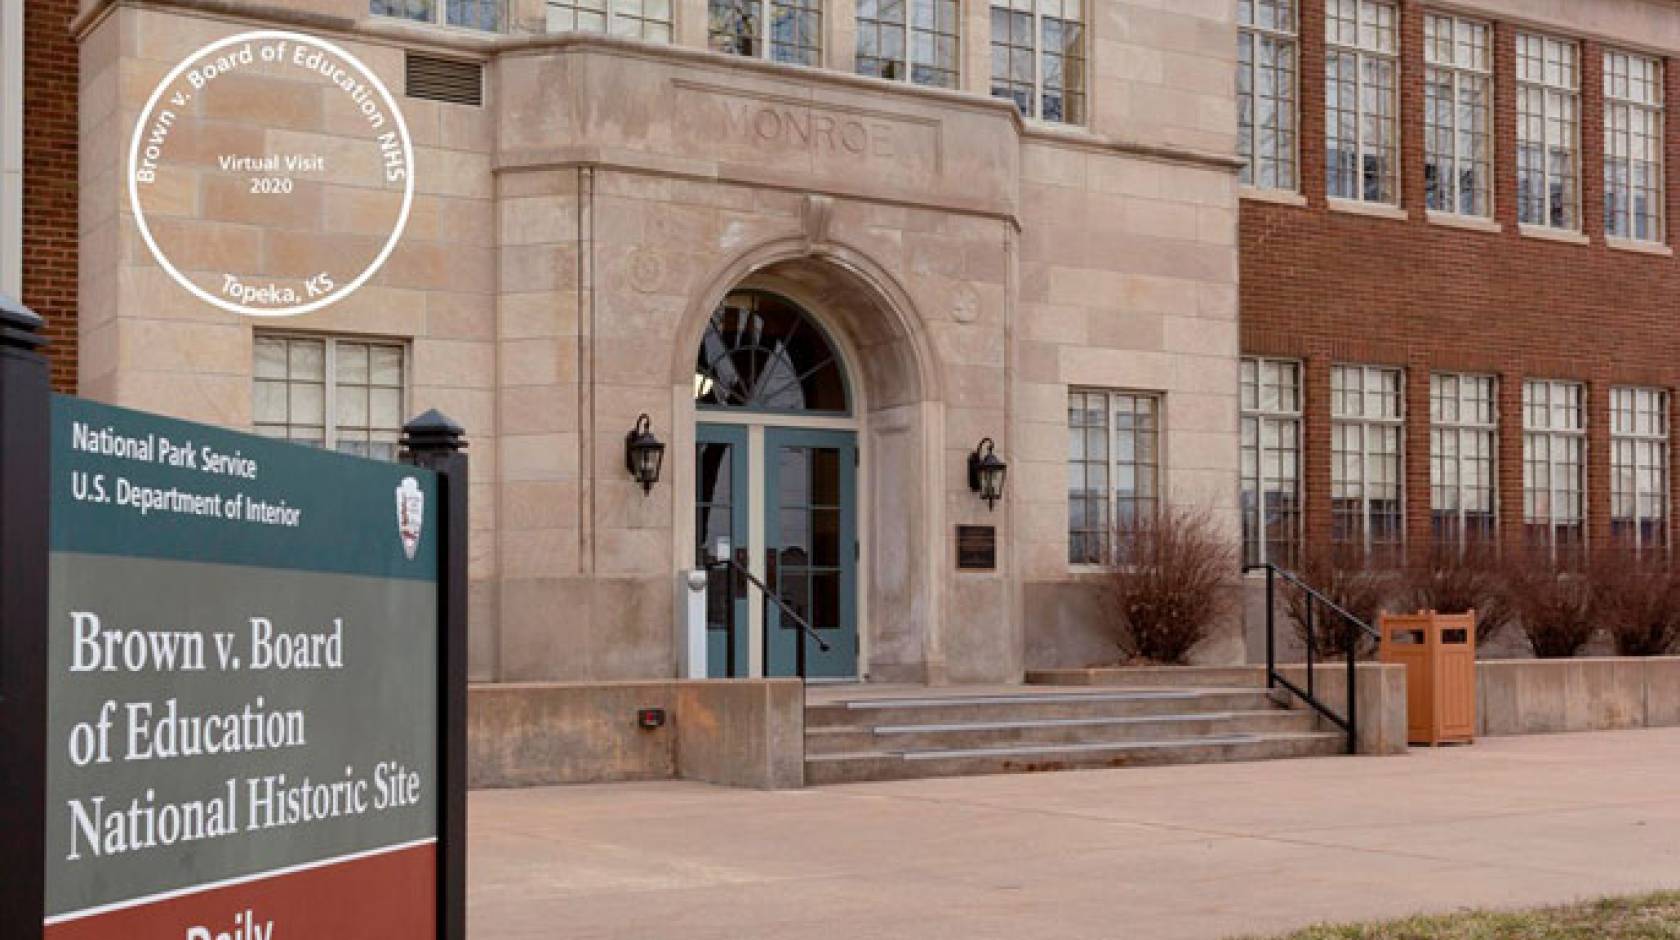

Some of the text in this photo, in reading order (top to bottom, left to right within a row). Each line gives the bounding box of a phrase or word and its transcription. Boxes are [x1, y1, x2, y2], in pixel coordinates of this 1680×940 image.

[722, 101, 896, 157] MONROE
[72, 421, 257, 479] National Park Service
[71, 471, 301, 527] U.S. Department of Interior
[69, 611, 344, 672] Brown v. Board
[68, 695, 306, 766] of Education
[66, 761, 421, 861] National Historic Site
